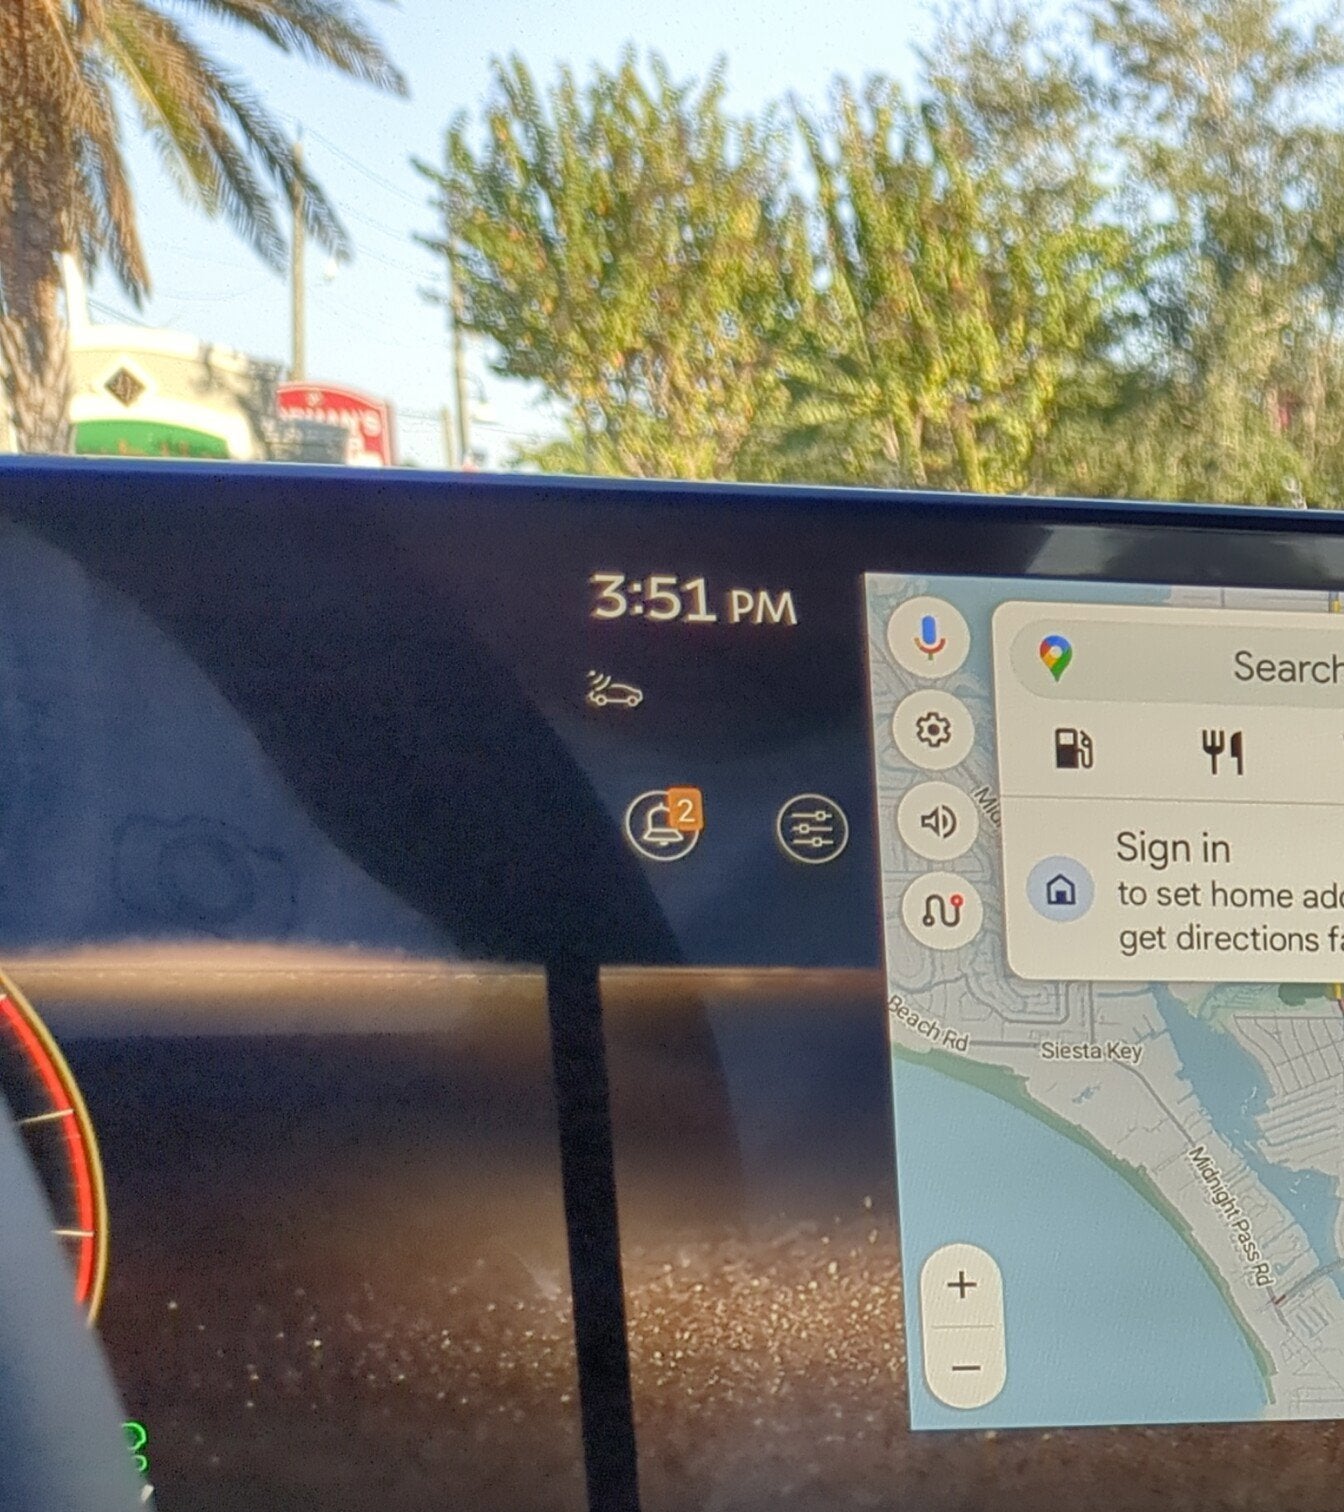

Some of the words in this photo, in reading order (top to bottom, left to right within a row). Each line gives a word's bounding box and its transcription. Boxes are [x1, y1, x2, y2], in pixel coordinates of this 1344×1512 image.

[589, 571, 717, 622] 3:51
[729, 589, 798, 625] PM
[676, 798, 697, 823] 2
[1116, 830, 1191, 870] Sign
[1202, 831, 1231, 863] in
[1118, 881, 1147, 906] to
[1157, 881, 1201, 907] set
[1211, 882, 1293, 908] home
[1119, 926, 1168, 957] get
[1176, 924, 1320, 953] directions
[943, 1029, 970, 1052] Rd
[1041, 1041, 1101, 1060] Siesta
[1108, 1043, 1143, 1064] Key
[1189, 1145, 1239, 1223] Midnight
[1231, 1220, 1262, 1264] Pass
[1254, 1258, 1274, 1288] Rd
